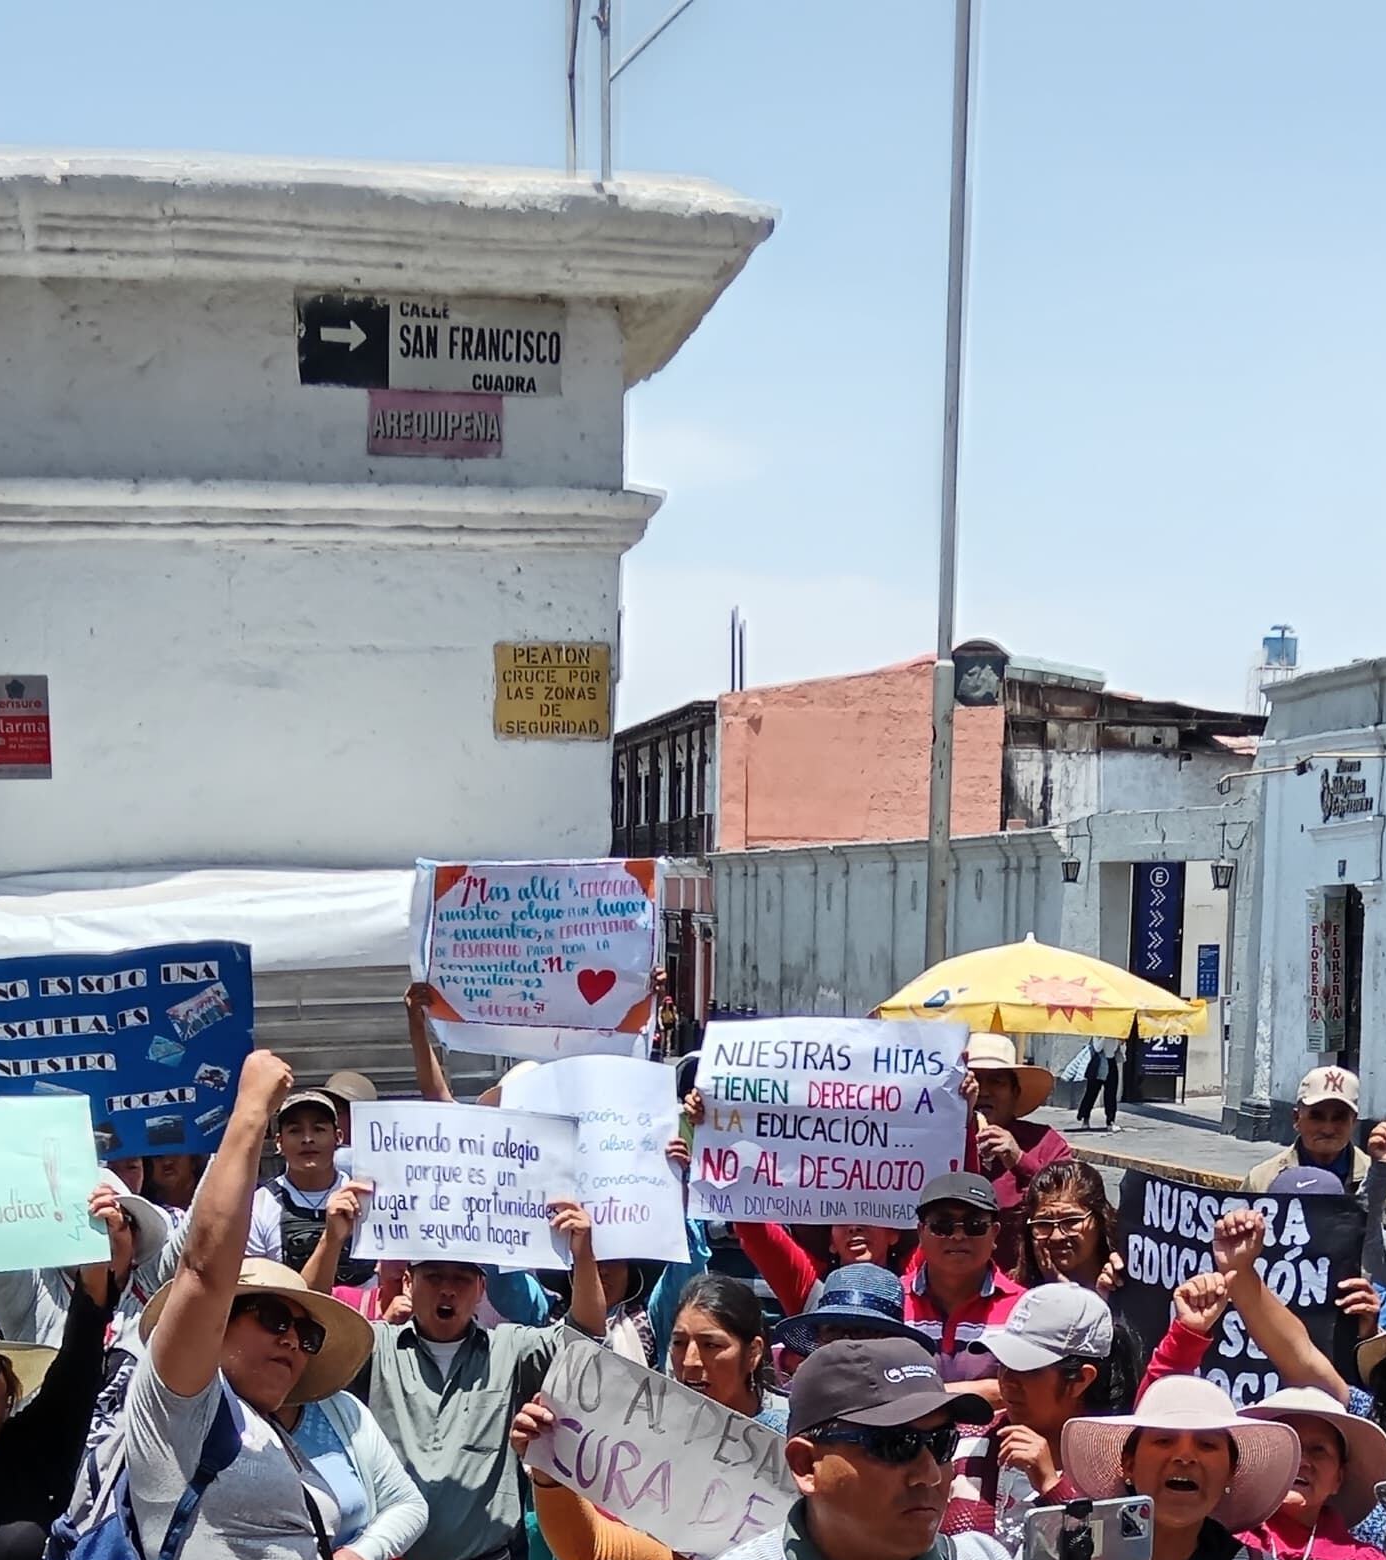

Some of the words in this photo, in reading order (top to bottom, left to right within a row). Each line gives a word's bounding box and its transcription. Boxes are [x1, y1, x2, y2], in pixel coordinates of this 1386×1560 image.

[400, 302, 449, 319] CALLE
[400, 325, 438, 358] SAN
[449, 326, 560, 364] FRANCISCO
[472, 374, 536, 393] CUADRA
[514, 647, 590, 664] PEATON
[502, 670, 556, 683] CRUCE
[569, 670, 600, 683] POR
[507, 686, 534, 700] LAS
[544, 686, 597, 700] ZONAS
[540, 704, 562, 717] DE
[506, 720, 599, 734] SEGURIDAD
[439, 903, 499, 922] nuestro
[513, 901, 565, 923] colegio
[595, 898, 646, 916] lugar
[41, 978, 70, 996] ES
[80, 970, 146, 994] SOLO
[162, 963, 216, 983] UNA
[1310, 925, 1319, 1021] FLORERIA
[1332, 925, 1341, 1020] FLORERIA
[119, 1009, 148, 1028] ES
[714, 1041, 851, 1071] NUESTRAS
[107, 1089, 195, 1112] HOGAR
[808, 1081, 902, 1112] DERECHO
[915, 1088, 934, 1114] A
[714, 1108, 743, 1133] LA
[370, 1121, 451, 1153] Defiendo
[459, 1134, 485, 1156] mi
[493, 1128, 541, 1168] colegio
[405, 1164, 463, 1187] porque
[468, 1166, 486, 1185] es
[497, 1171, 517, 1187] un
[701, 1147, 739, 1182] NO
[752, 1151, 784, 1188] AL
[799, 1154, 925, 1192] DESALOJO
[371, 1181, 420, 1220] lugar
[430, 1186, 450, 1211] de
[463, 1186, 560, 1221] oportunidades
[701, 1193, 733, 1215] UNA
[820, 1200, 846, 1216] UNA
[373, 1224, 384, 1250] y
[389, 1224, 409, 1240] un
[420, 1216, 481, 1248] segundo
[487, 1215, 532, 1255] hogar
[550, 1351, 603, 1413] NO
[623, 1376, 669, 1435] AL
[549, 1417, 672, 1515] CURA
